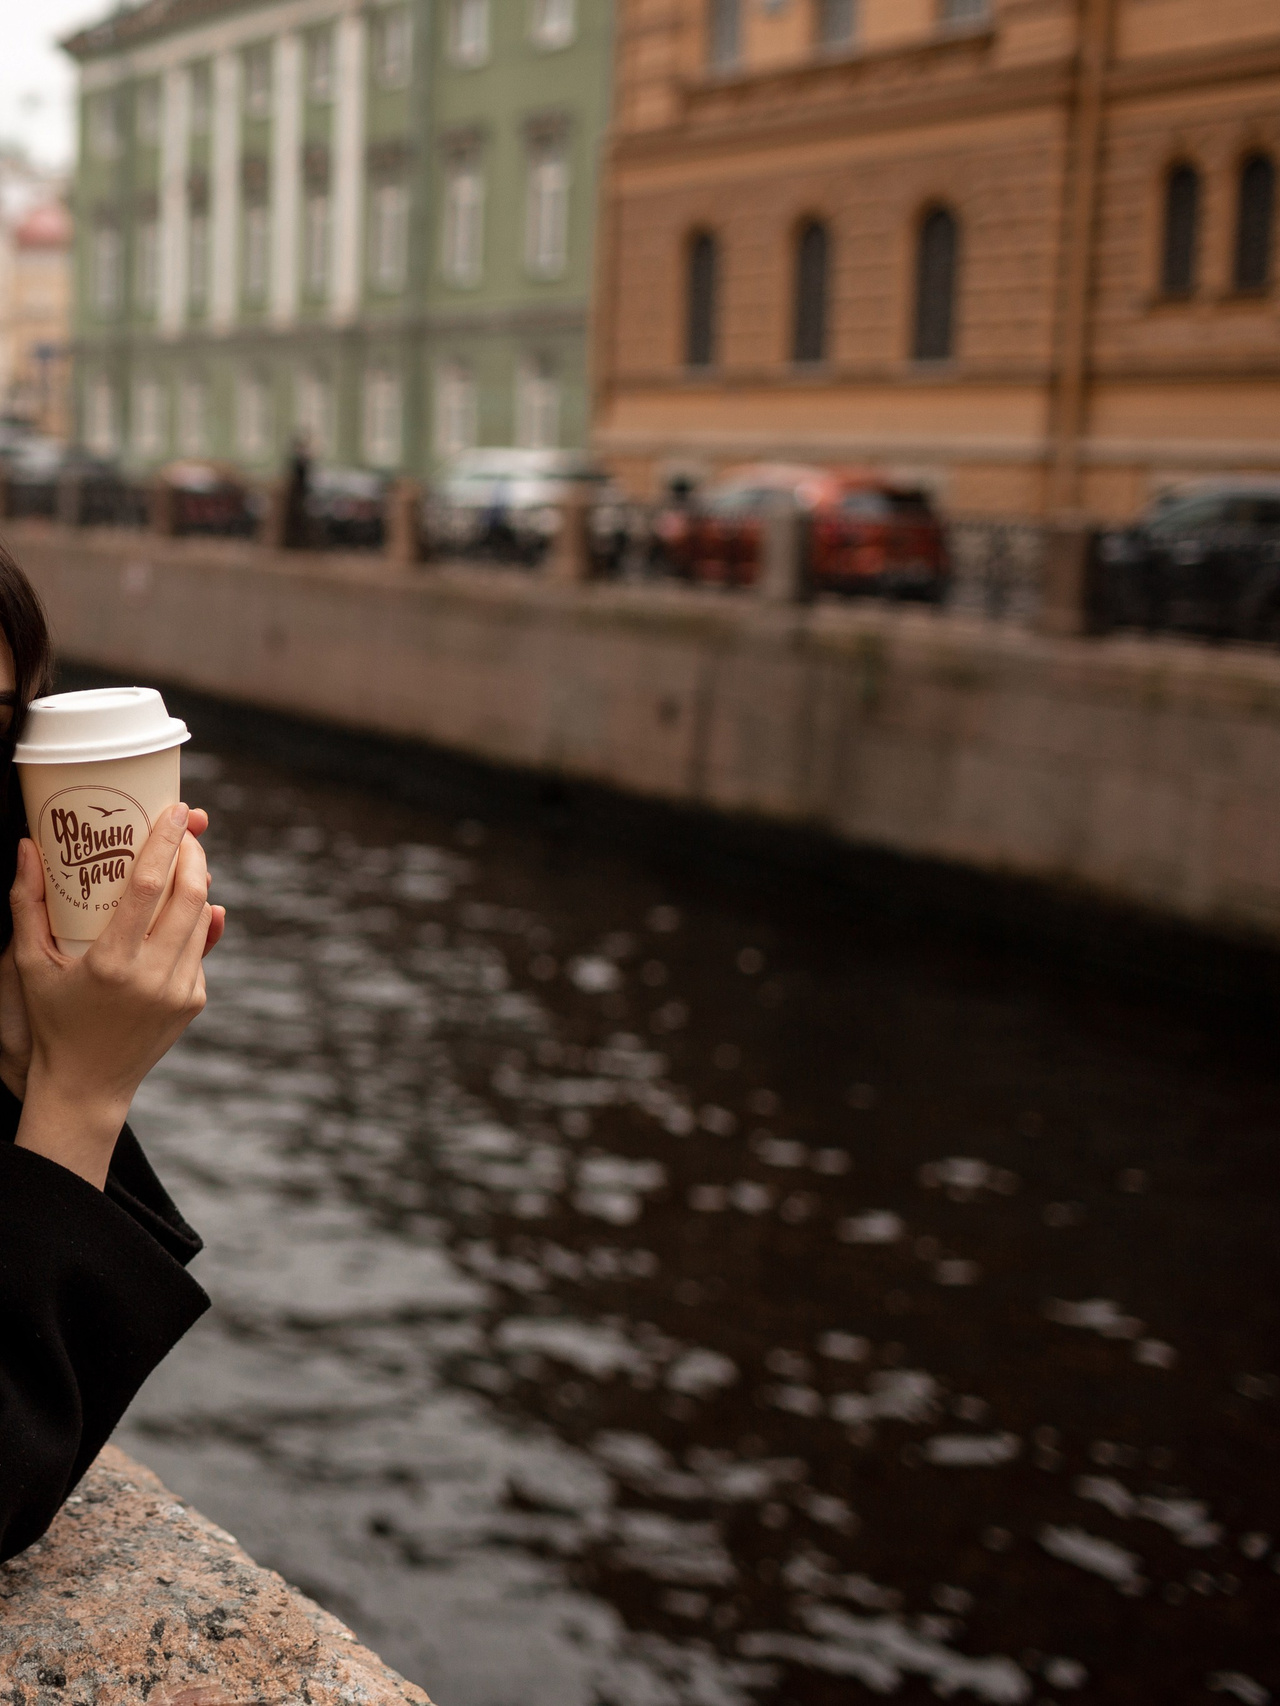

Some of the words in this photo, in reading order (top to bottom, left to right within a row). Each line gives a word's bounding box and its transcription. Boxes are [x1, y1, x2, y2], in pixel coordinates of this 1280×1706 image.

[50, 808, 135, 867] Федина
[43, 858, 89, 911] СЕМЕЙНЫЙ
[95, 896, 123, 912] FOO
[78, 858, 125, 900] дача
